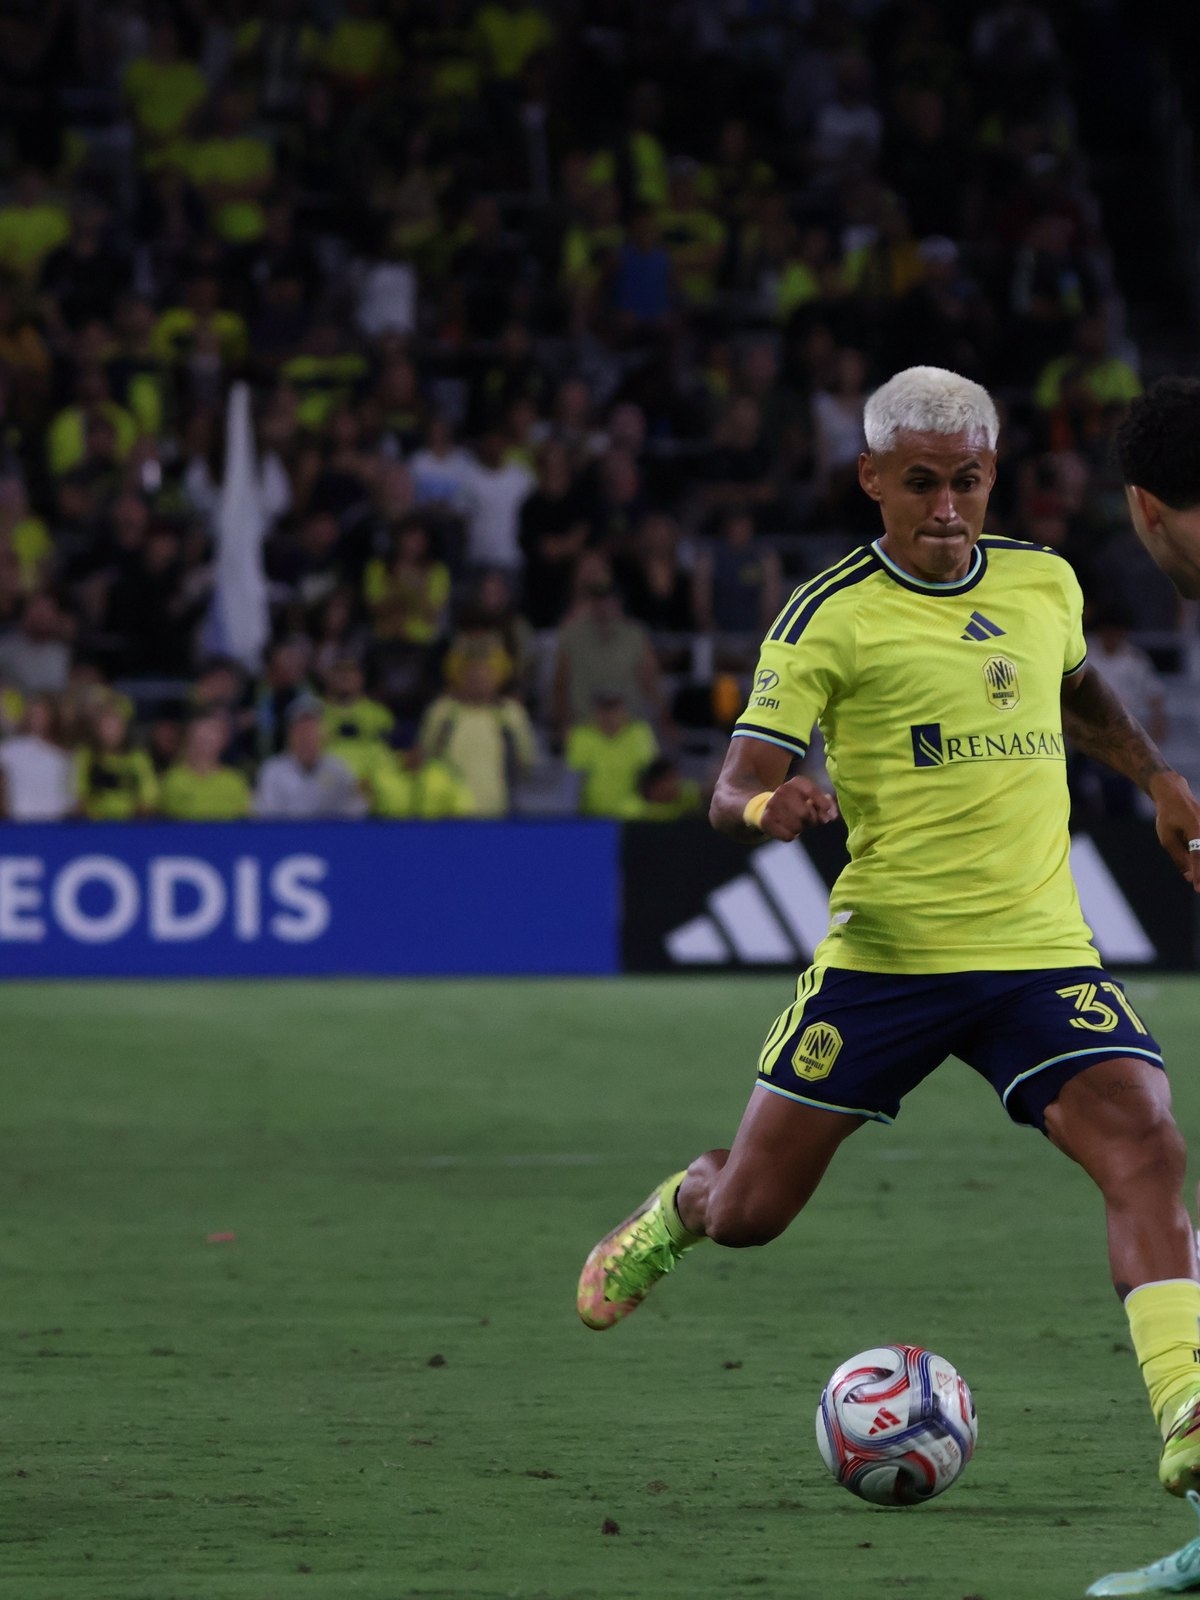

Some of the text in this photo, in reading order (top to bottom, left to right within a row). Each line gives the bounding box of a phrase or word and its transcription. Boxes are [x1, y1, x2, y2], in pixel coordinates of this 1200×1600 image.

[945, 731, 1064, 761] RENASAN
[0, 854, 331, 944] EODIS
[1055, 981, 1149, 1036] 31
